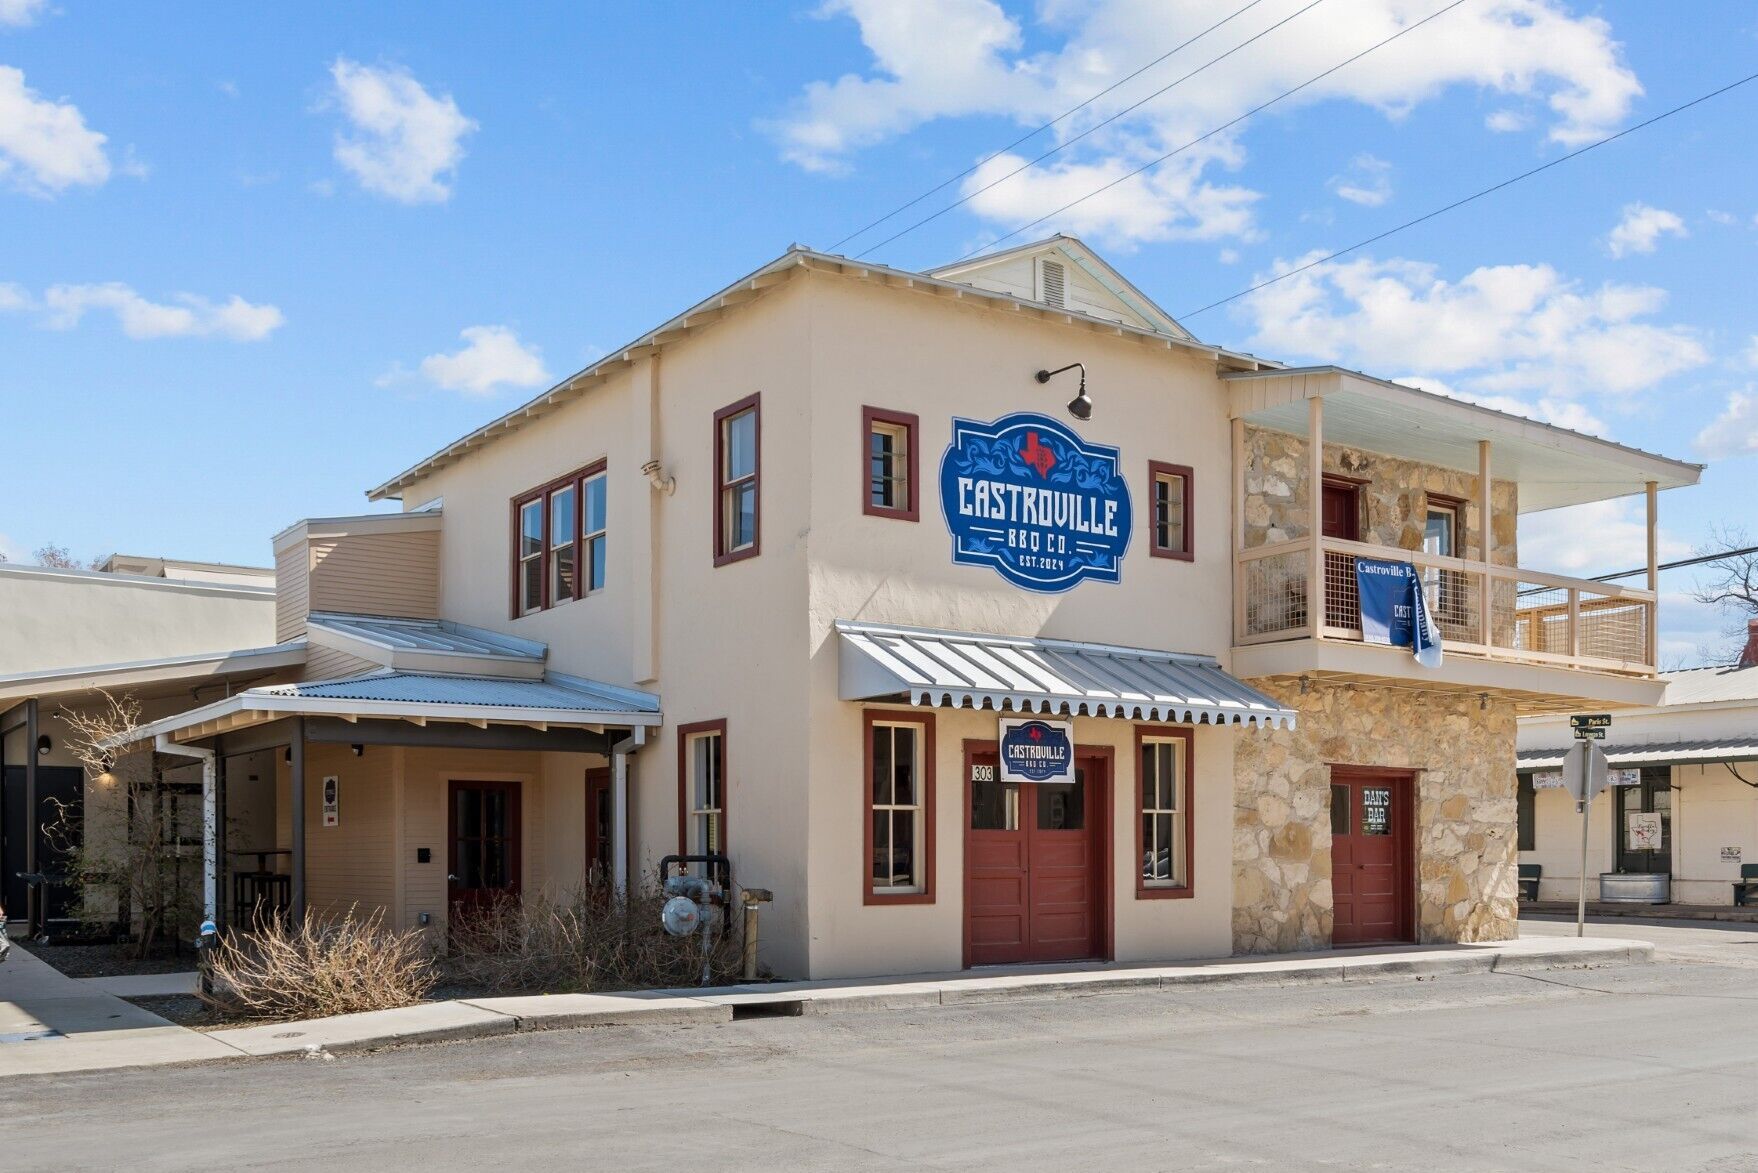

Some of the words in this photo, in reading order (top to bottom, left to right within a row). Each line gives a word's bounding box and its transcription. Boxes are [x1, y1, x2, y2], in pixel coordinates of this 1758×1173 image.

[958, 477, 1118, 537] CASTROVILLE
[1008, 528, 1040, 552] BBQ
[1047, 534, 1072, 554] CO.
[1357, 561, 1404, 577] Castroville
[1588, 718, 1602, 726] Paris
[1602, 717, 1610, 725] St.
[1008, 744, 1065, 760] CASTROVILLE
[974, 766, 992, 780] 303
[1363, 790, 1389, 806] DAN'S
[1367, 807, 1386, 823] BAR
